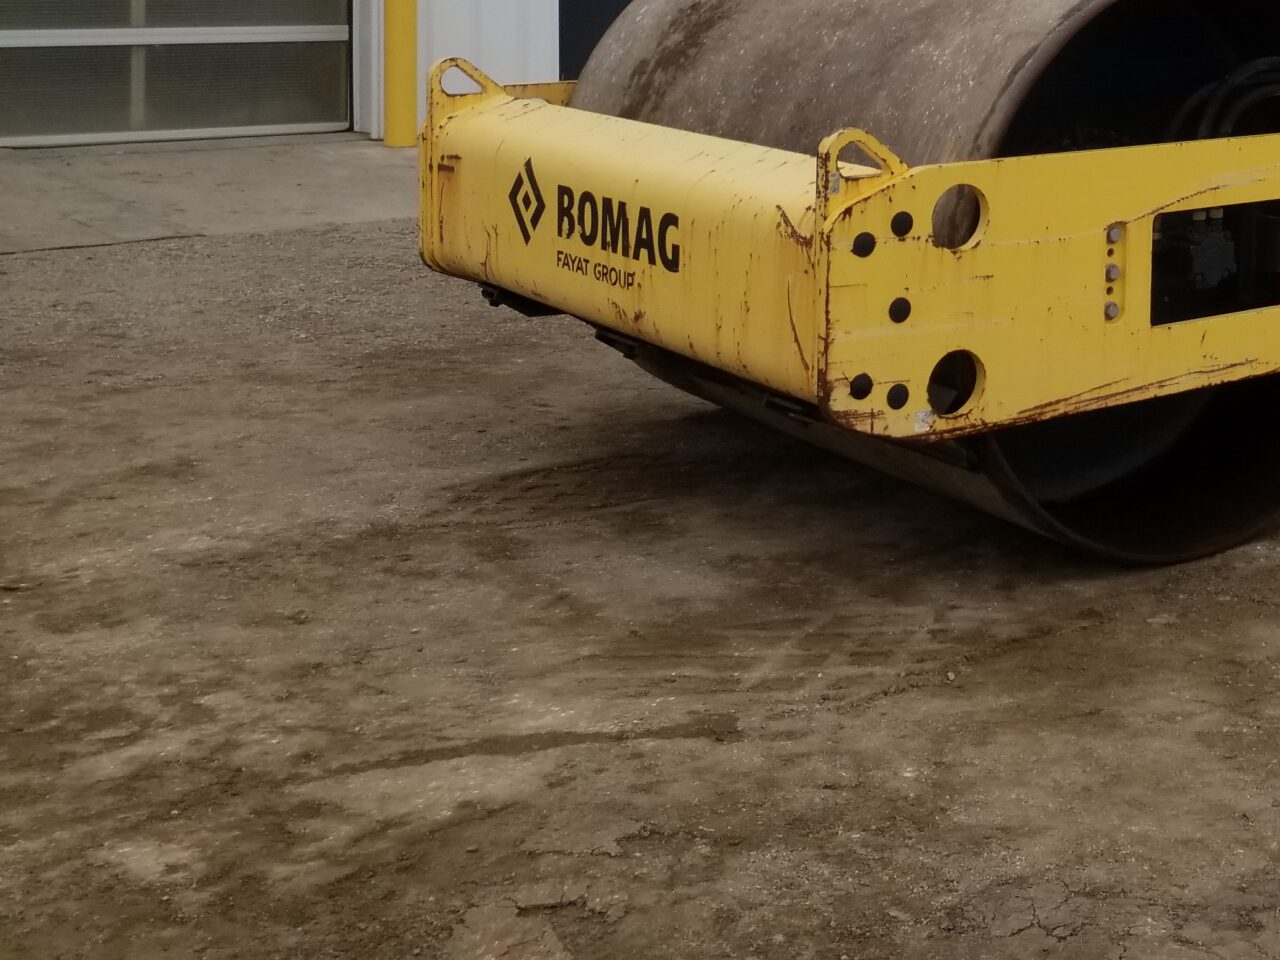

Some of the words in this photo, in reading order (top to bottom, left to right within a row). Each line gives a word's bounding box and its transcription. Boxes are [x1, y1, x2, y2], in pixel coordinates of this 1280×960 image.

[557, 184, 681, 273] BOMAG
[556, 250, 590, 277] FAYAT
[593, 262, 636, 291] GROUP
